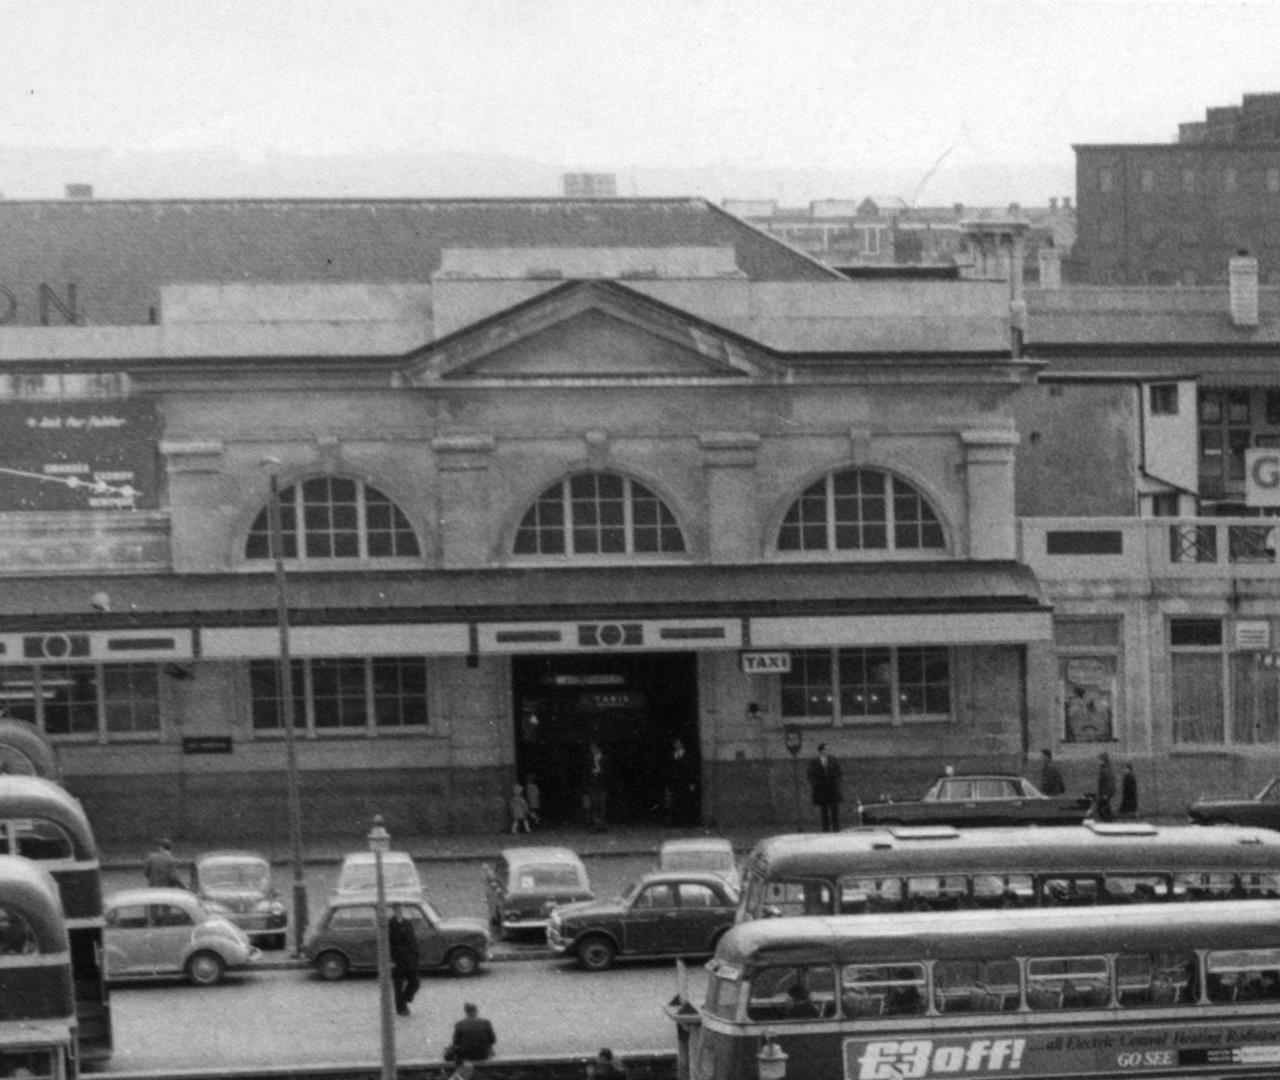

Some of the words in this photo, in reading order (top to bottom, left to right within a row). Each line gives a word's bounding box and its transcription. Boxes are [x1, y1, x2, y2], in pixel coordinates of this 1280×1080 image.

[745, 655, 789, 669] TAXI
[857, 1039, 934, 1080] £3
[931, 1038, 1027, 1073] off!
[1116, 1052, 1141, 1067] GO
[1145, 1050, 1173, 1066] SEE
